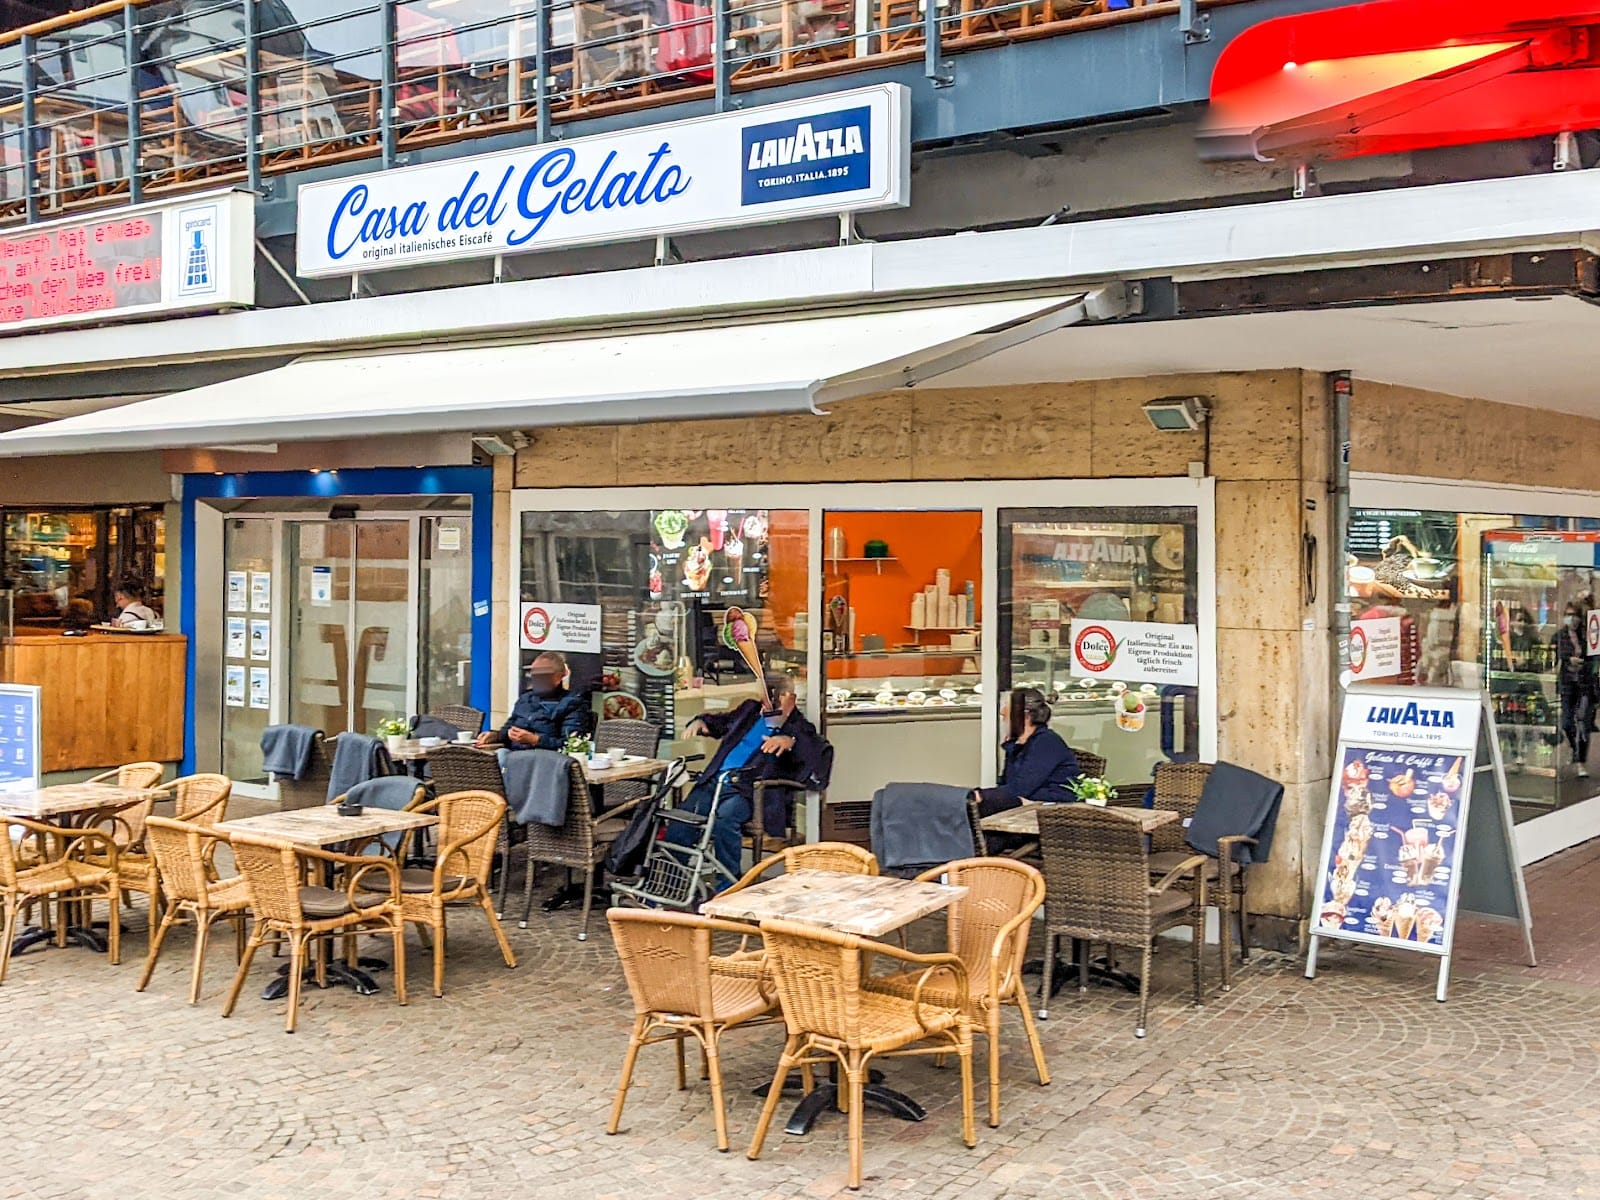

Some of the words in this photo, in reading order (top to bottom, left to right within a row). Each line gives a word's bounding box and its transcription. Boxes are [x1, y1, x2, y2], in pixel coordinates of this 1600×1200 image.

[748, 122, 864, 171] LAVAZZA
[327, 184, 430, 259] Casa
[438, 165, 508, 231] del
[507, 142, 693, 246] Gelato
[362, 243, 397, 260] original
[399, 237, 456, 254] italienisches
[459, 231, 493, 246] Eiscafé
[1144, 631, 1175, 642] Original
[1082, 641, 1109, 652] Dolce
[1127, 639, 1167, 650] Italienische
[1168, 641, 1180, 650] Eis
[1127, 648, 1151, 657] Eigene
[1152, 648, 1193, 659] Produktion
[1136, 656, 1160, 666] täglich
[1162, 657, 1183, 667] frisch
[1366, 702, 1455, 729] LAVAZZA
